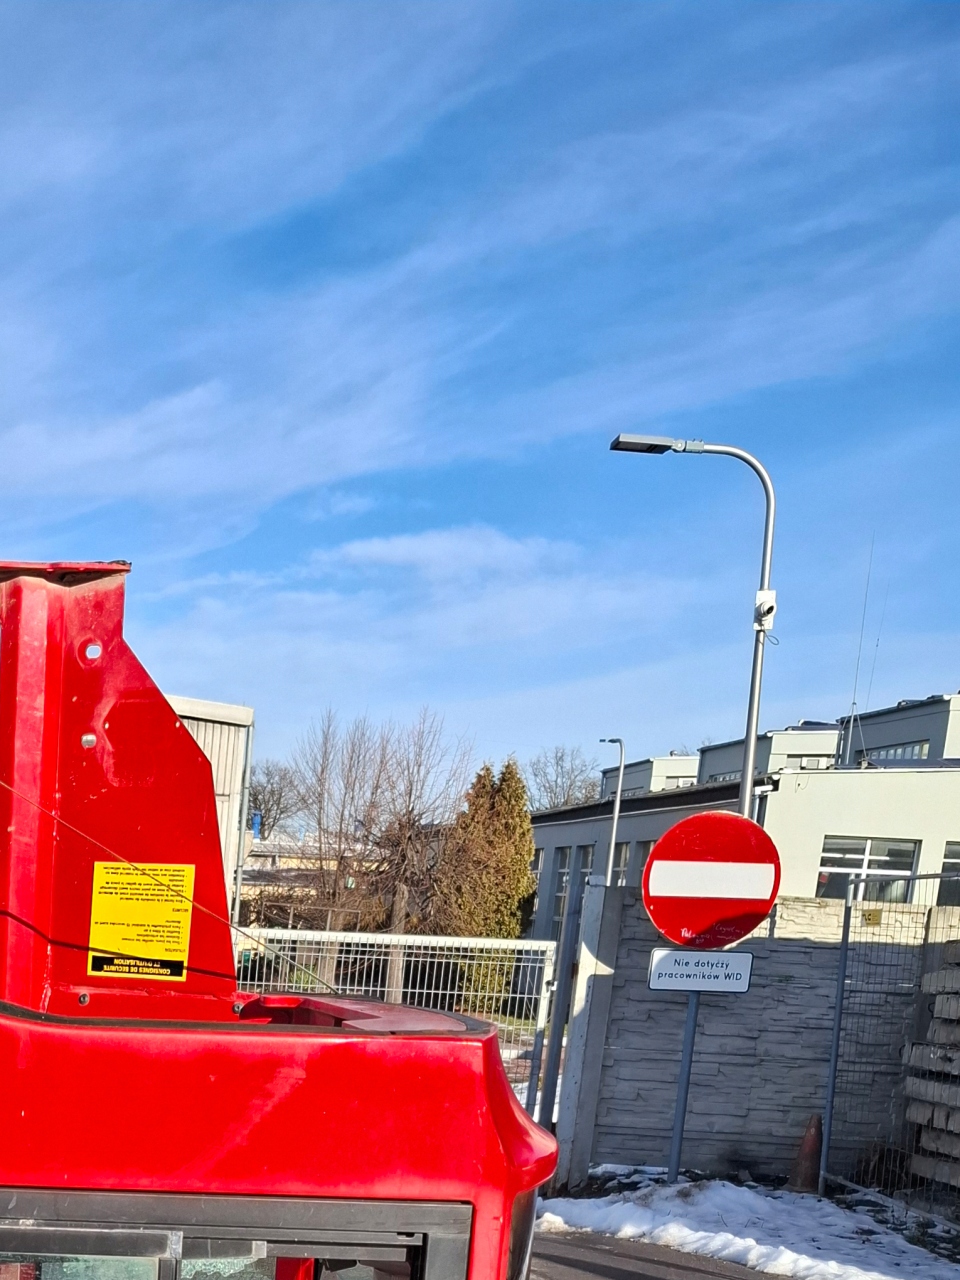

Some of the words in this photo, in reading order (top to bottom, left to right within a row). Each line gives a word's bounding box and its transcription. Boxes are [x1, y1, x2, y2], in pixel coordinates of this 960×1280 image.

[673, 958, 690, 967] Nie
[657, 971, 720, 980] pracowników
[723, 972, 743, 981] WID
